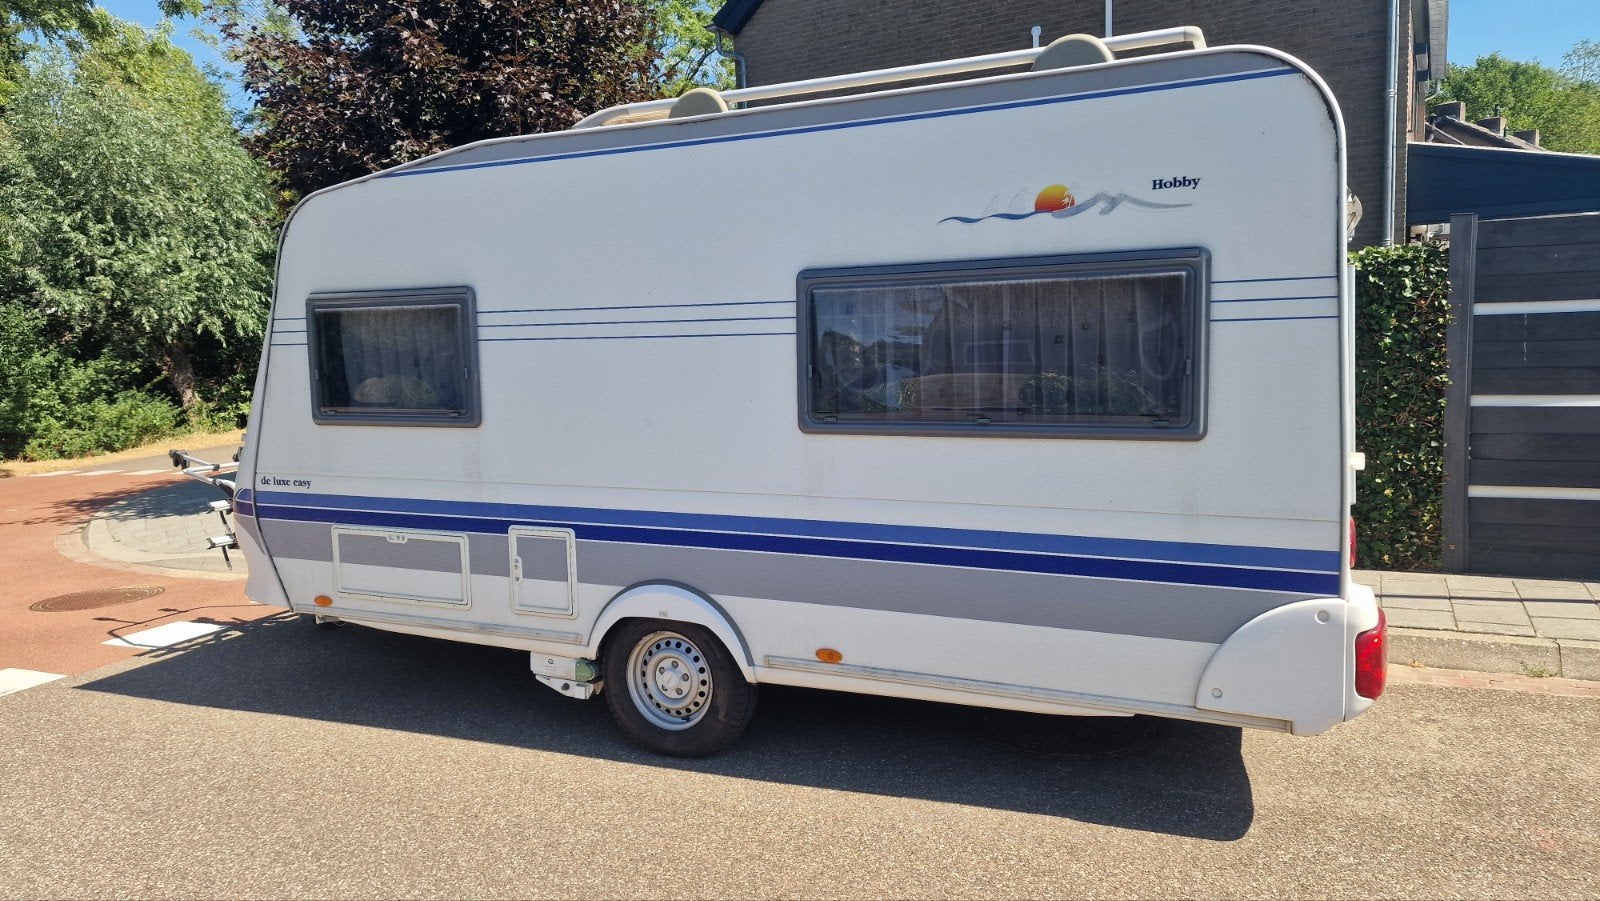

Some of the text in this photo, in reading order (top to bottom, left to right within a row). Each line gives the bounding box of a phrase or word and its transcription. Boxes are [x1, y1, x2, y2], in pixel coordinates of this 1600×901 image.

[1152, 176, 1201, 190] Hobby
[260, 475, 311, 489] de luxe easy
